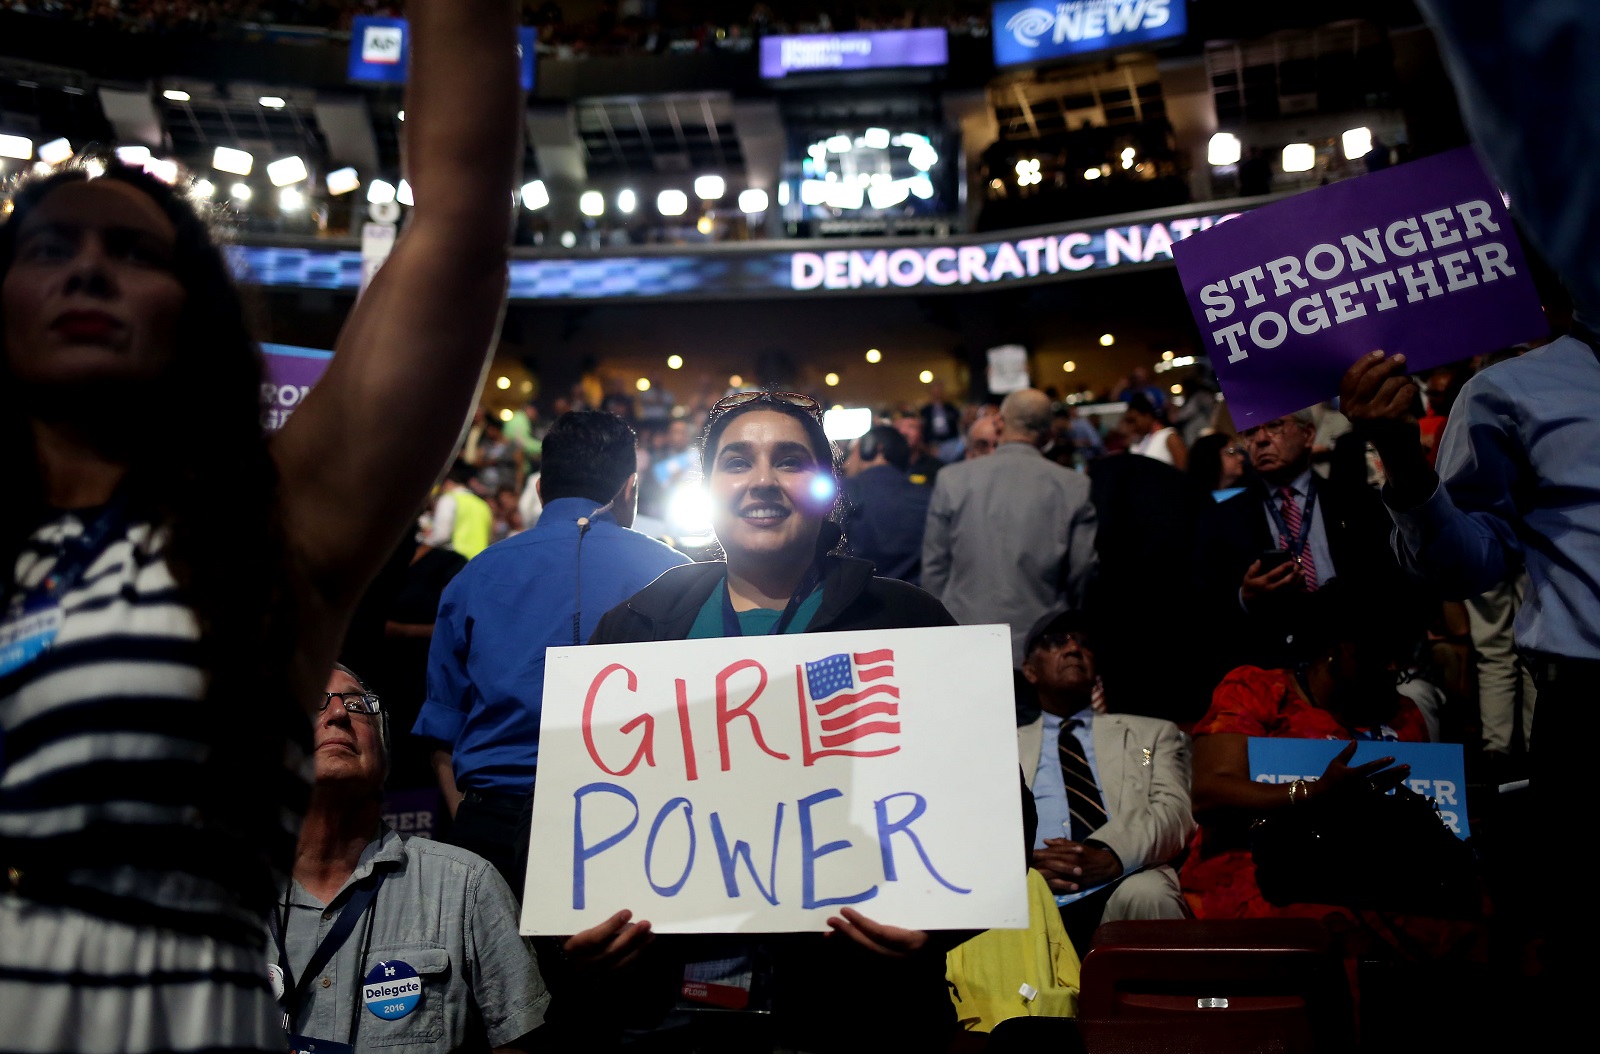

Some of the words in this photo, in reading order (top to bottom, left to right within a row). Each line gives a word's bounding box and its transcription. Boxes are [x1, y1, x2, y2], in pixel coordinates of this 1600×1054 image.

[1052, 0, 1171, 45] NEWS
[791, 232, 1095, 290] DEMOCRATIC
[1200, 200, 1500, 323] STRONGER
[1212, 242, 1516, 364] TOGETHER
[582, 650, 901, 781] GIRL
[572, 782, 973, 910] POWER
[365, 982, 419, 999] Delegate
[384, 1003, 405, 1014] 2016
[684, 988, 708, 997] FLOOR
